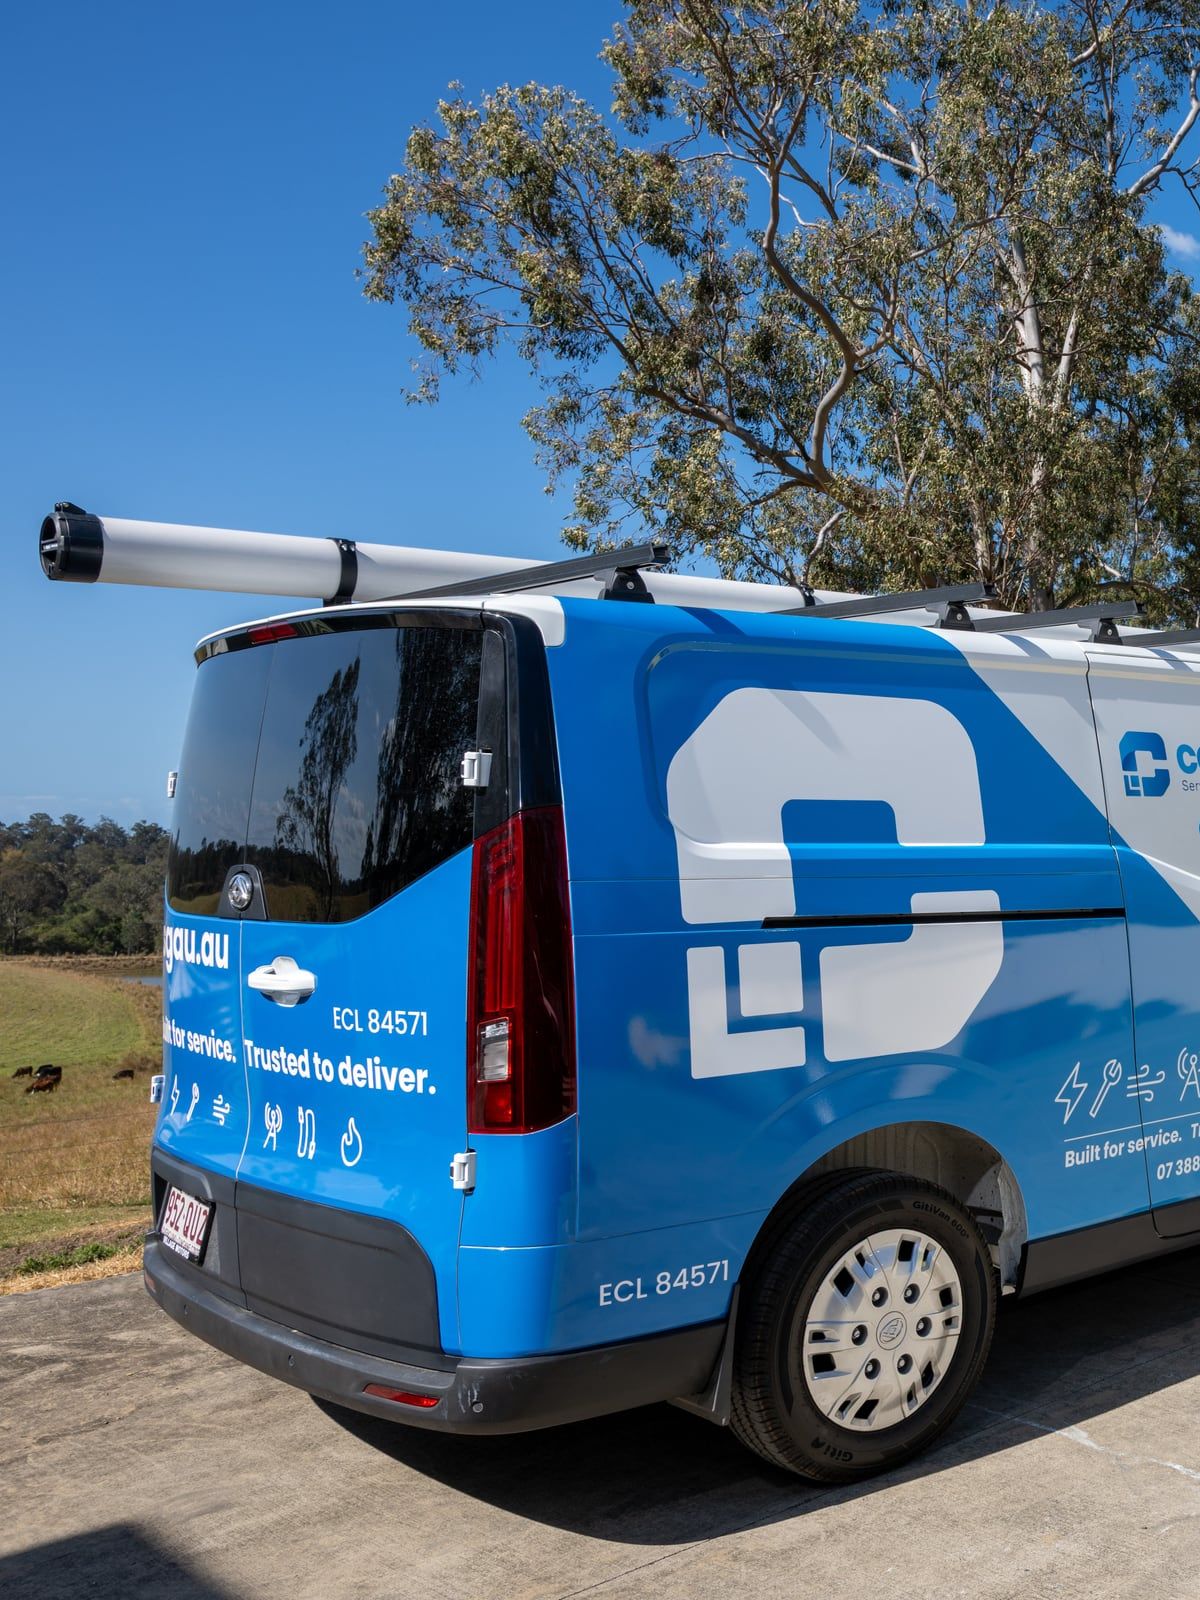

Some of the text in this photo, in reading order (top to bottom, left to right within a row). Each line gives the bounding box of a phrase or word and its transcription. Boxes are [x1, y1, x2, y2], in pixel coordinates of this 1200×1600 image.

[164, 925, 229, 974] gau.au
[333, 1007, 428, 1036] ECL 84571
[172, 1019, 186, 1049] for
[187, 1029, 237, 1064] service.
[244, 1039, 311, 1079] Trusted
[313, 1052, 335, 1083] to
[338, 1056, 437, 1095] deliver.
[1064, 1145, 1101, 1168] Built
[1104, 1141, 1125, 1159] for
[1127, 1129, 1182, 1154] service.
[1157, 1161, 1174, 1181] 07
[599, 1259, 729, 1306] ECL 84571
